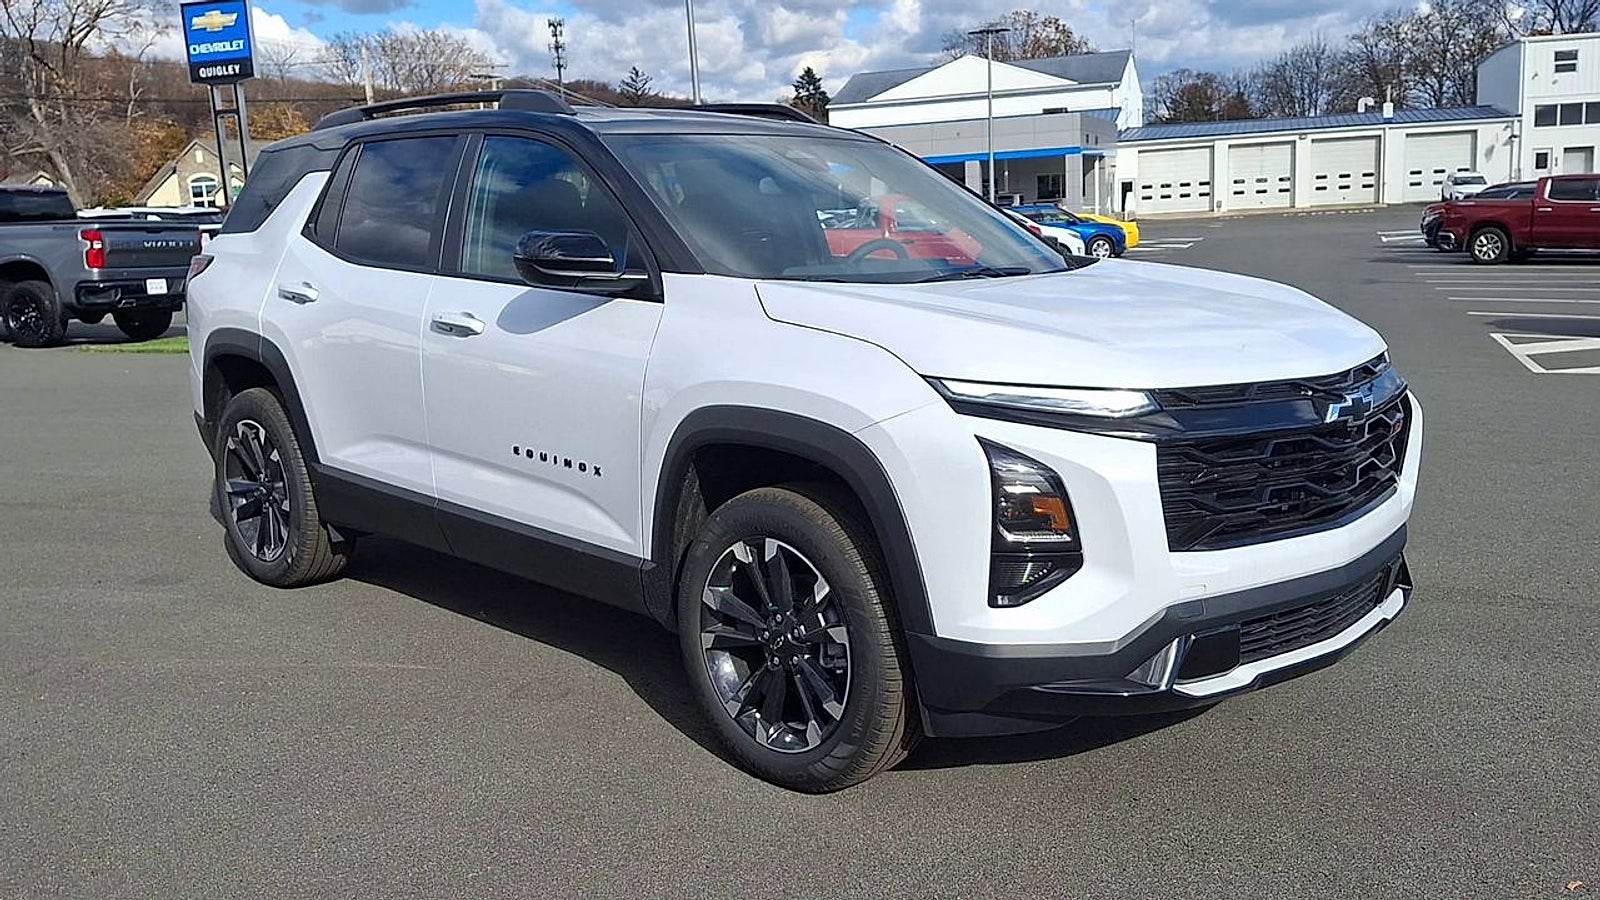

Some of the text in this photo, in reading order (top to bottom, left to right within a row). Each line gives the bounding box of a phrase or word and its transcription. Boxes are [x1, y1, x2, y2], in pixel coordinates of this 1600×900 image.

[190, 40, 244, 55] CHEVROLET
[199, 64, 240, 78] QUIGLEY
[513, 446, 602, 477] EQUINOX
